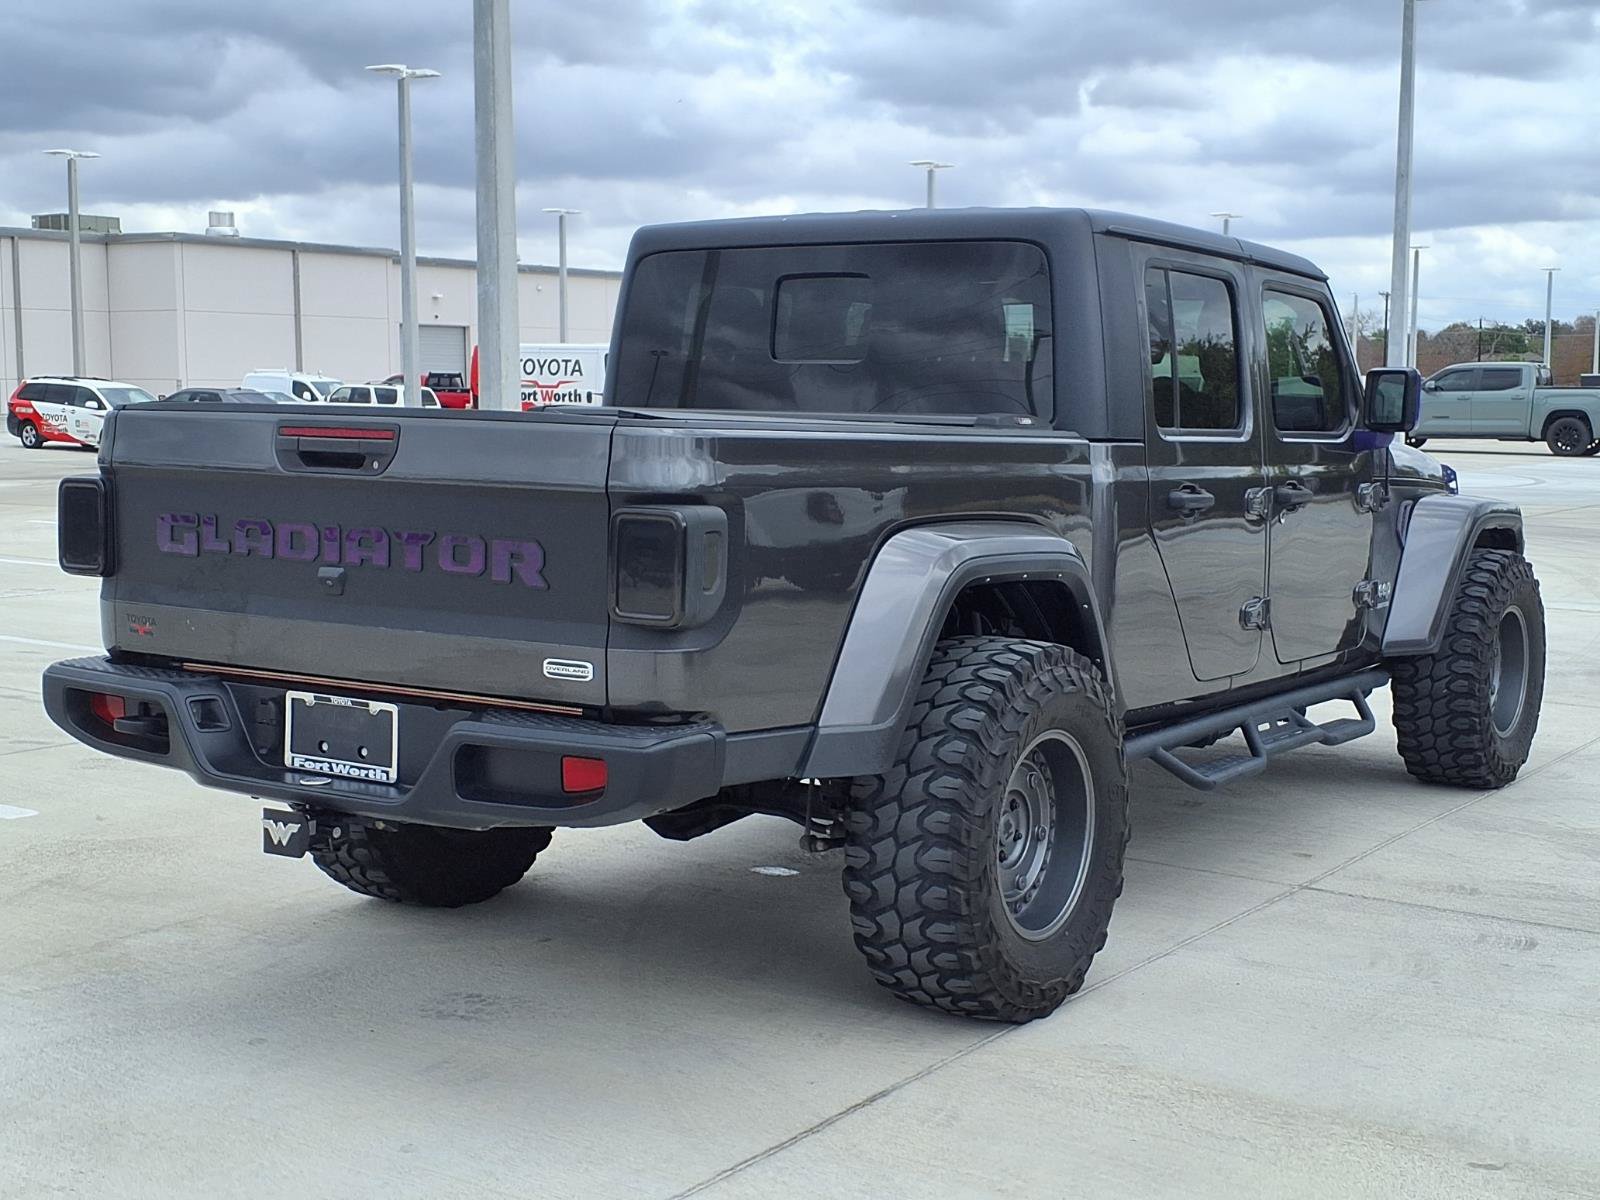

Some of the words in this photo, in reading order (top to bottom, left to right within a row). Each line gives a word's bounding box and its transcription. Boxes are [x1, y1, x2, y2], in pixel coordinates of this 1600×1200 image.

[520, 358, 583, 376] OYOTA
[520, 390, 538, 402] ort
[540, 388, 582, 403] Worth
[42, 413, 68, 422] TOYOTA
[155, 513, 550, 590] GLADIATOR
[126, 613, 157, 625] TOYOTA
[545, 665, 590, 675] OVERLAND
[330, 697, 353, 706] TOYOTA
[294, 758, 331, 773] Fort
[331, 763, 387, 781] Worth
